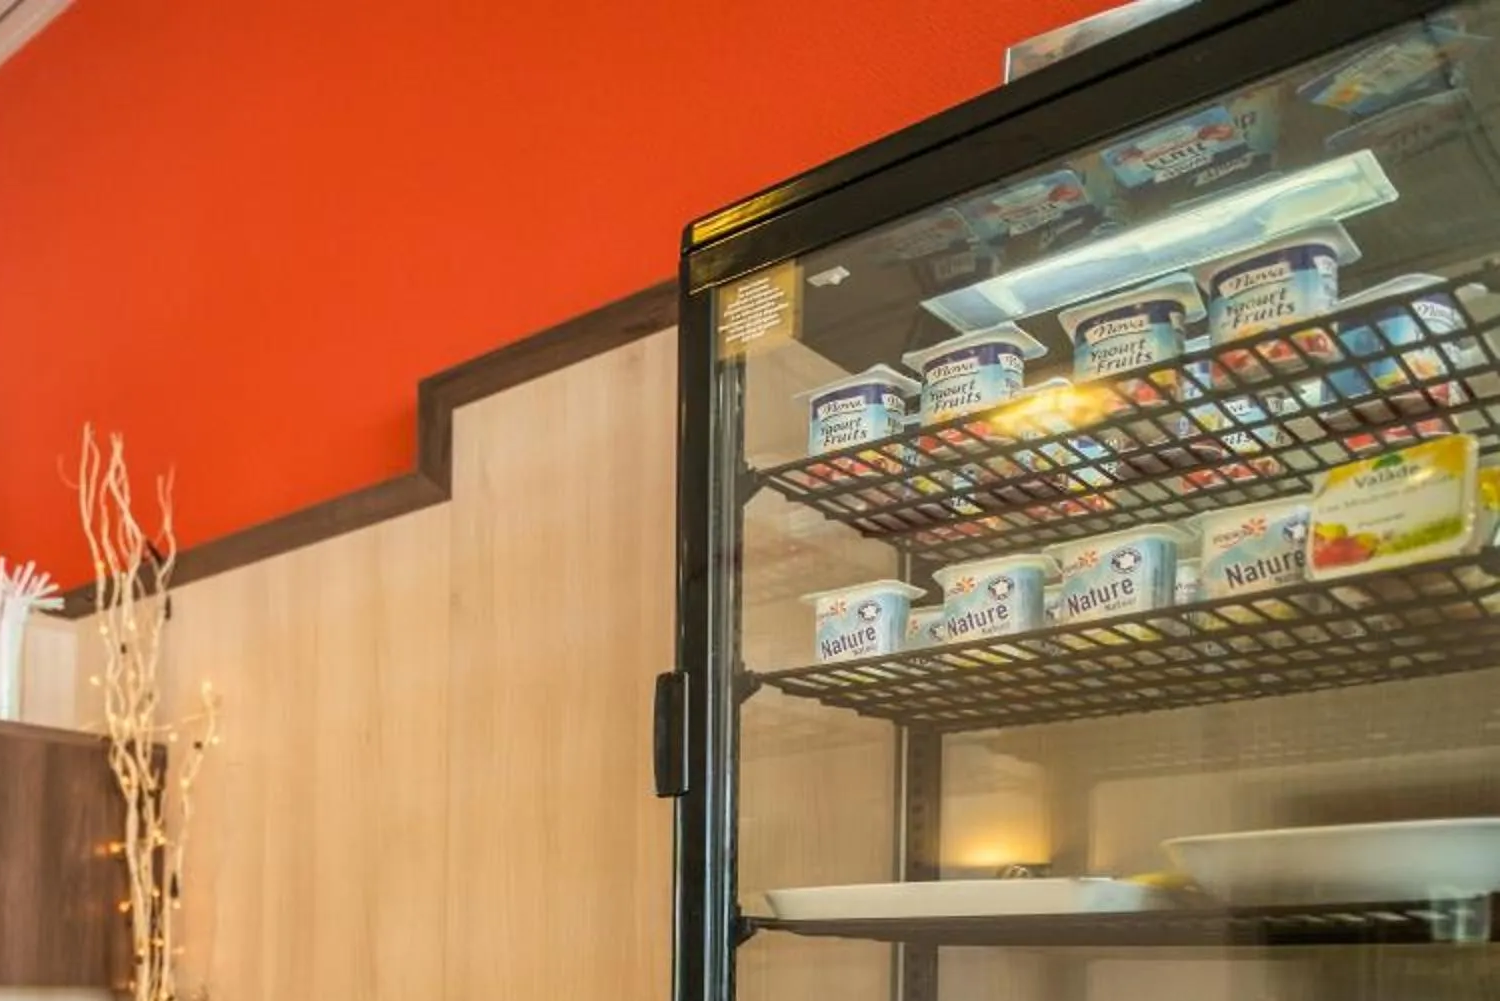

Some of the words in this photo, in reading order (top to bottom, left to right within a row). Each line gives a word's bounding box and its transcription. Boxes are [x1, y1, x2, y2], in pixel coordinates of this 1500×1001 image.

[1225, 549, 1306, 590] Nature
[1066, 577, 1135, 617] Nature
[947, 603, 1009, 638] Nature
[820, 625, 877, 660] Nature
